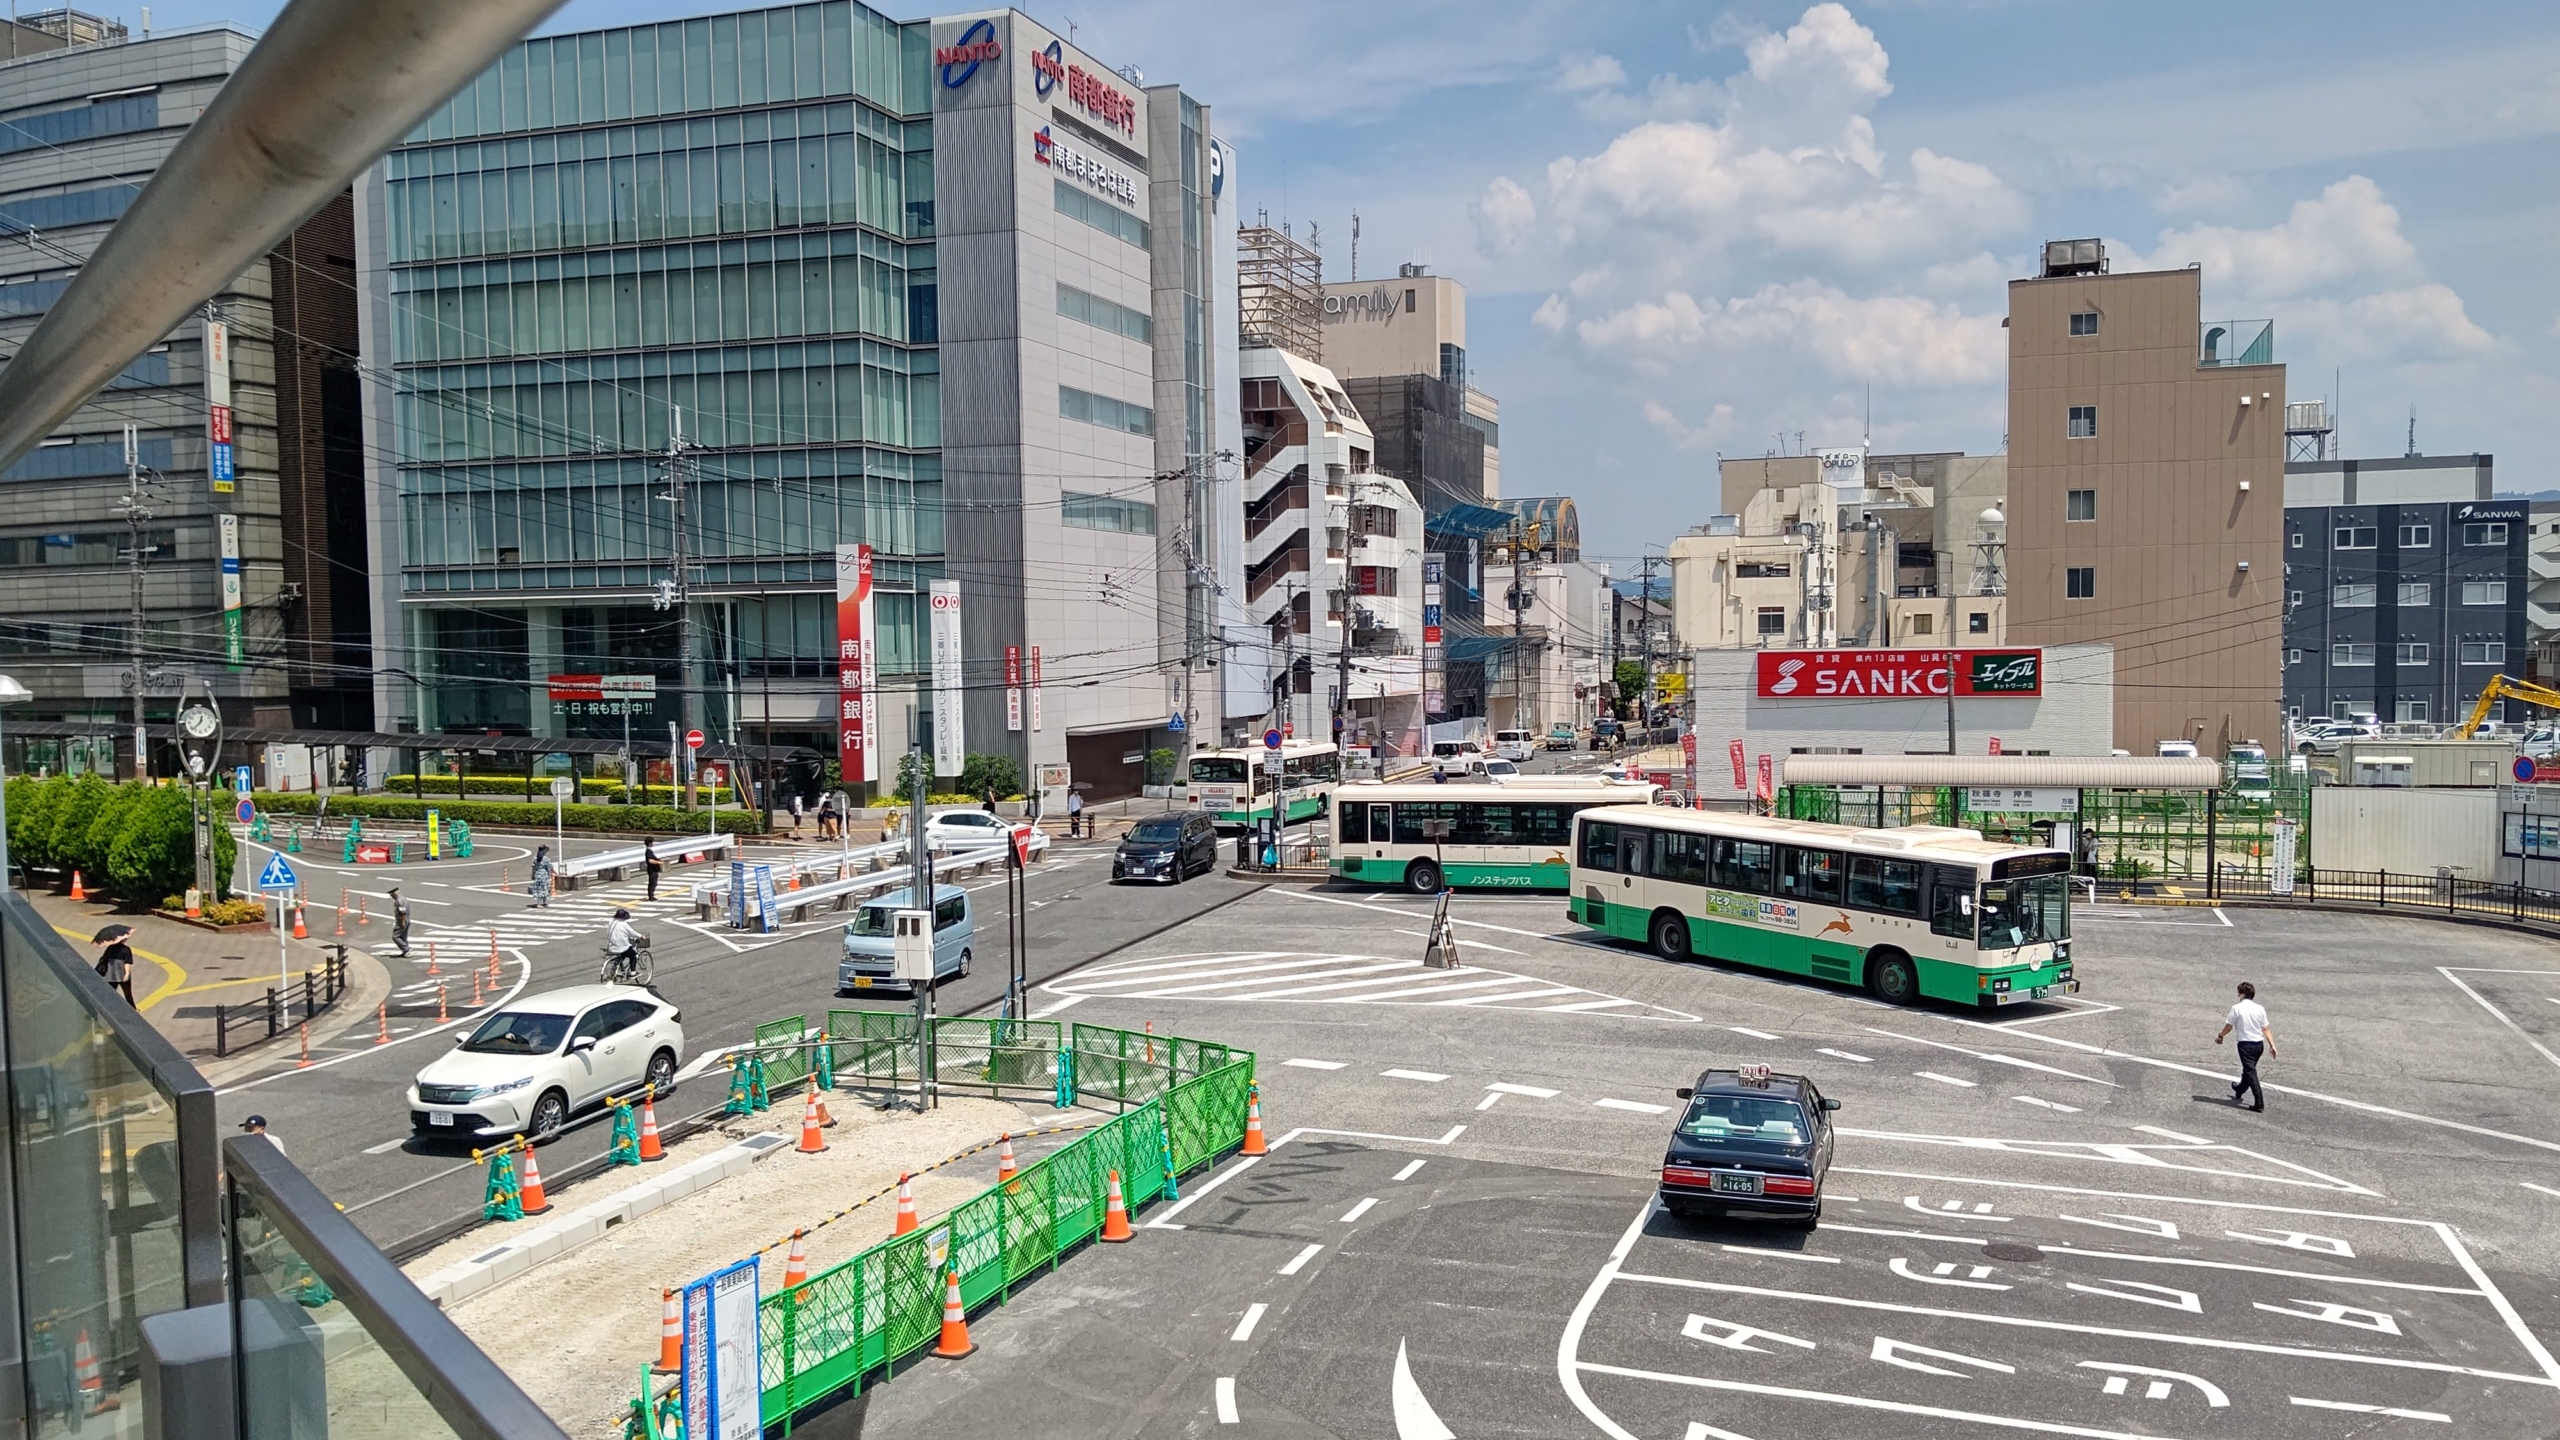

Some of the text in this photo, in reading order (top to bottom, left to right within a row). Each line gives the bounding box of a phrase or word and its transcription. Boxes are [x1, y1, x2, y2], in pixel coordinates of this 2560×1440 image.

[936, 41, 1001, 66] NANTO
[1032, 50, 1065, 83] NANTO
[1067, 64, 1135, 133] 南都銀行
[1053, 141, 1138, 203] 南都まほろば証券
[2473, 511, 2522, 519] SANWA
[1430, 605, 1438, 626] AGA
[1815, 654, 1840, 663] 賃貸
[1855, 653, 1905, 662] 県内13店舗
[1979, 657, 2037, 682] エイブル
[1815, 669, 1949, 694] SANKO
[841, 639, 863, 750] 南都銀行
[1658, 690, 1667, 701] P
[1972, 790, 2033, 798] 秋篠寺 押熊
[1470, 875, 1532, 885] ノンステップバス
[1742, 1067, 1757, 1076] TAXI
[1729, 1180, 1753, 1191] 16-05
[1721, 1245, 2404, 1336] タクシー
[1681, 1313, 2453, 1424] タクシー
